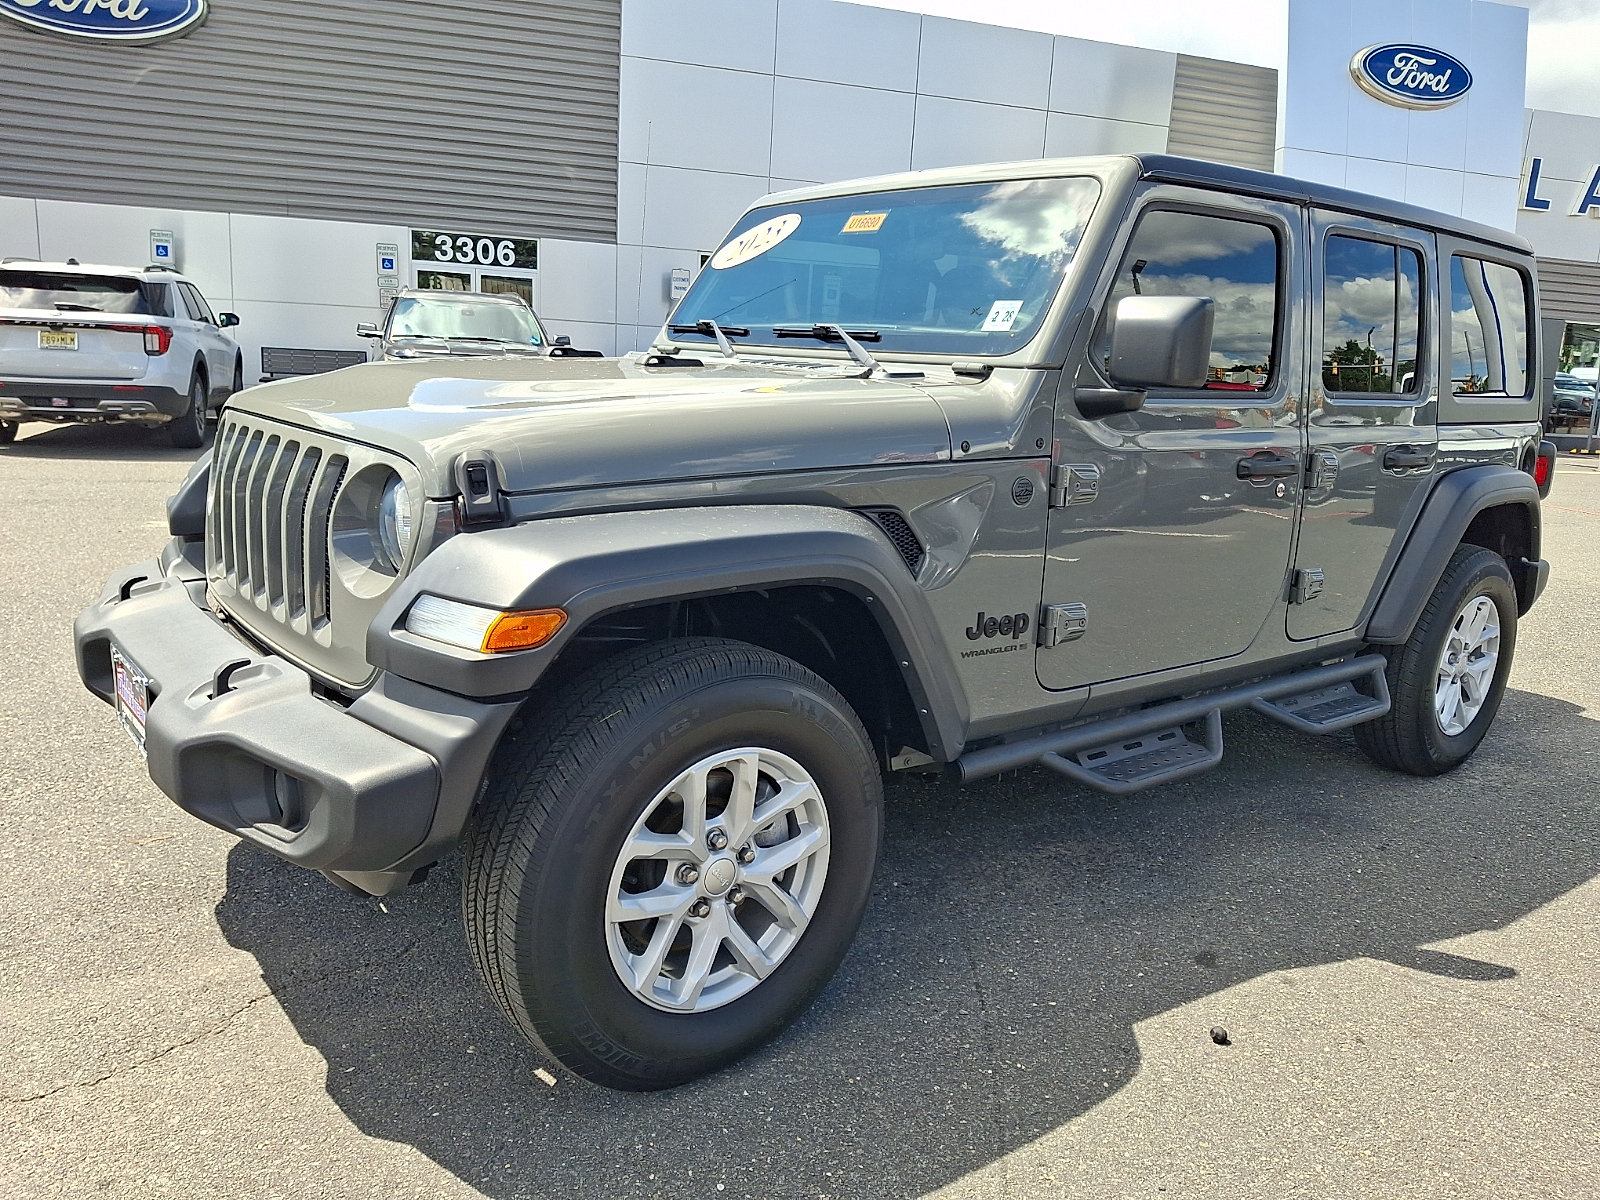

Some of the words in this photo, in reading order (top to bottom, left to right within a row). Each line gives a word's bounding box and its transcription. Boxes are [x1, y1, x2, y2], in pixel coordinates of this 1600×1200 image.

[1386, 52, 1453, 93] Ford
[434, 234, 516, 267] 3306
[966, 612, 1030, 640] Jeep
[960, 645, 1017, 659] WRANGLER
